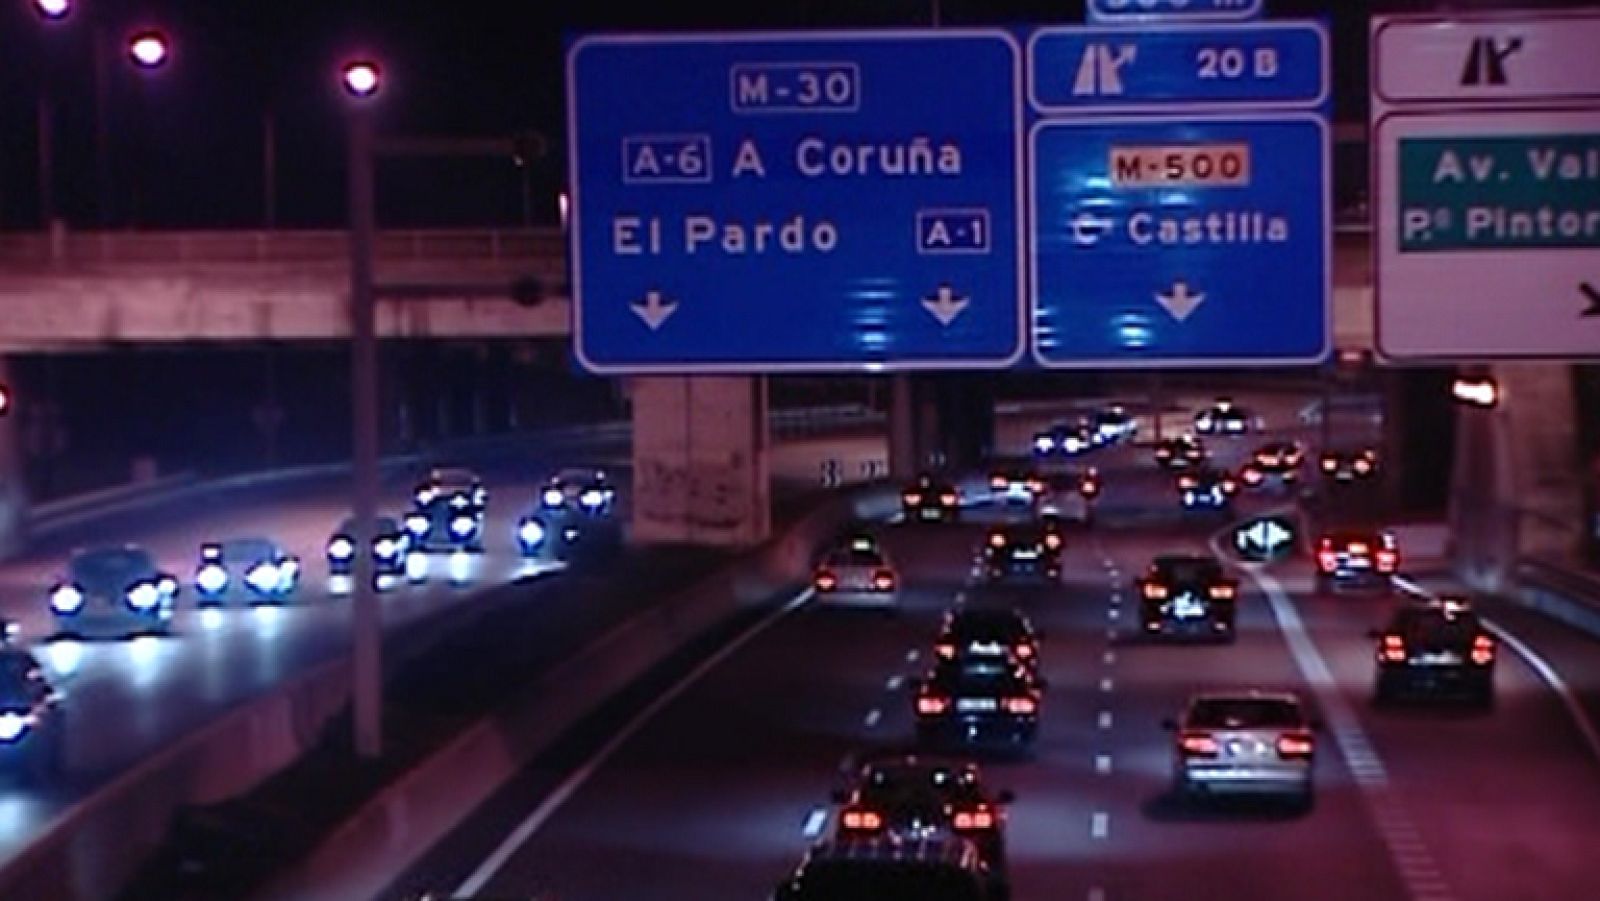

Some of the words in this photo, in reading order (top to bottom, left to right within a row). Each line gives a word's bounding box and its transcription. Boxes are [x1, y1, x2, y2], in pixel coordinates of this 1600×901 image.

[1197, 49, 1245, 78] 20
[1254, 49, 1278, 77] B
[738, 72, 851, 104] M-30
[633, 143, 703, 175] A-6
[732, 140, 765, 178] A
[796, 137, 962, 176] Coruña
[1116, 151, 1243, 181] M-500
[1432, 150, 1512, 184] Av.
[613, 217, 660, 254] El
[685, 214, 839, 253] Pardo
[926, 219, 984, 245] A-1
[1128, 211, 1289, 245] Castilla
